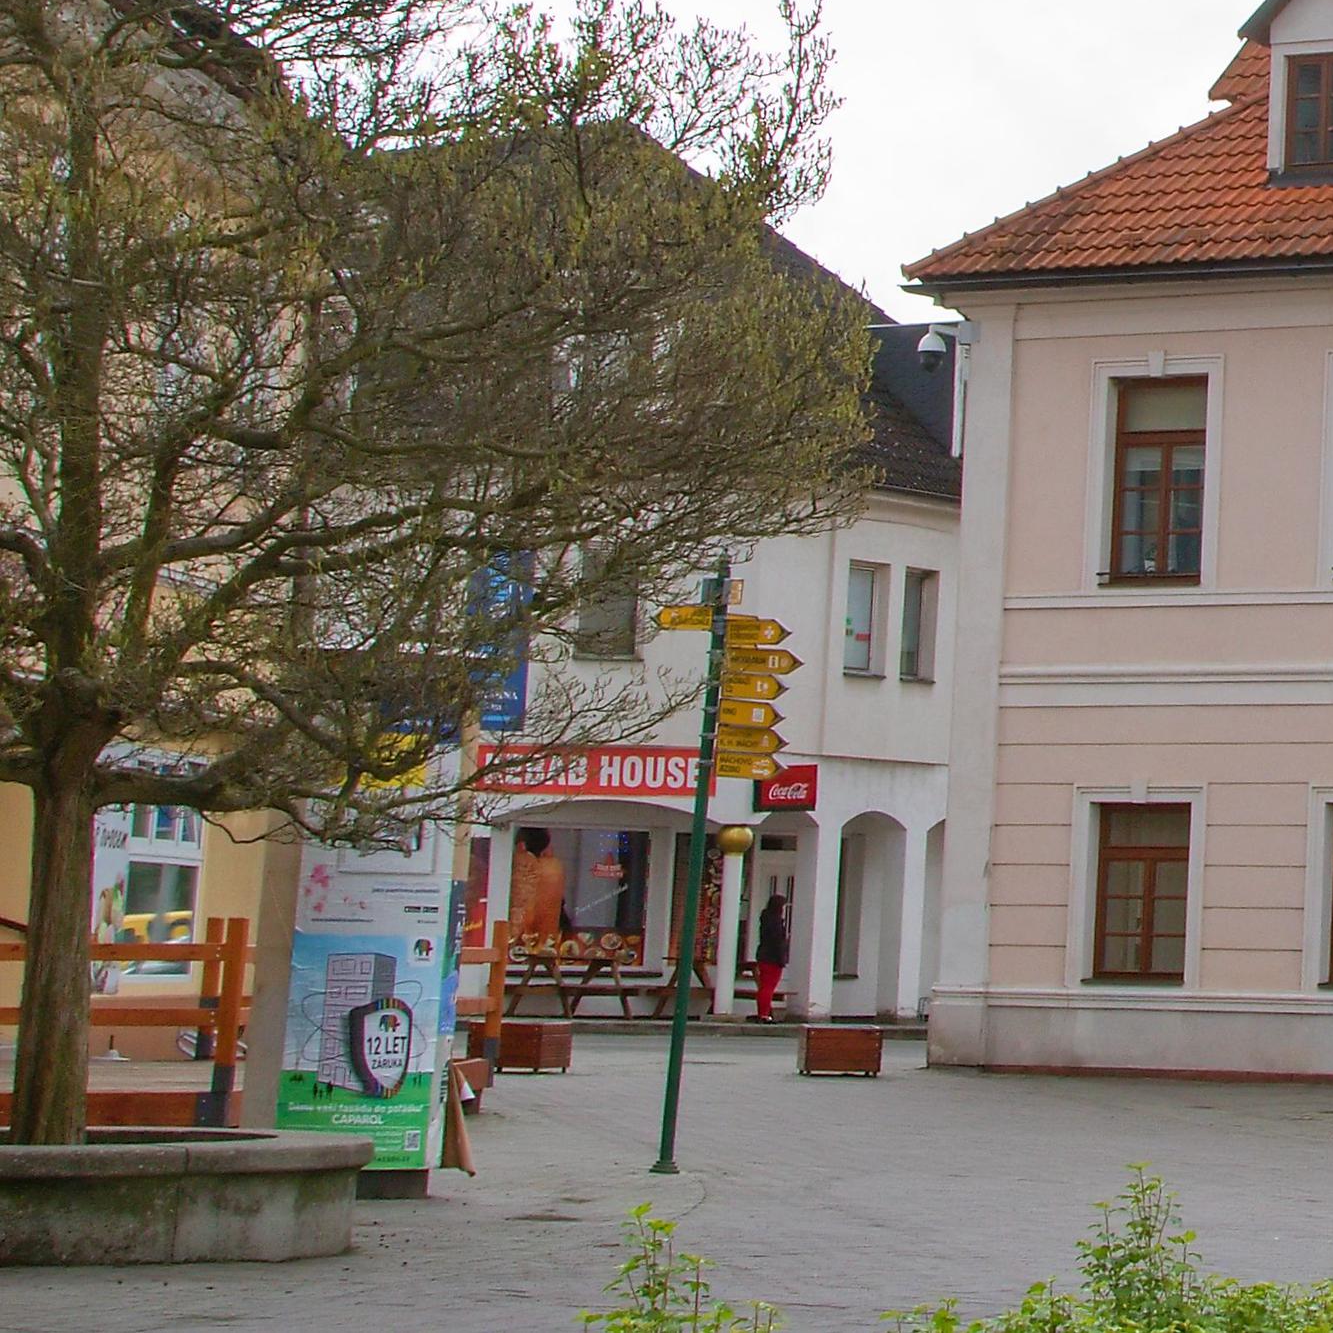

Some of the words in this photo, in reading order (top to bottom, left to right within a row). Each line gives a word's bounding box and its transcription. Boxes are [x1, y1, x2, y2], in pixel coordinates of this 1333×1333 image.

[601, 755, 701, 789] HOUSE
[367, 1037, 382, 1055] 12
[386, 1036, 407, 1055] LET
[372, 1058, 403, 1069] ZÁRUKA
[332, 1114, 385, 1125] CAPAROL
